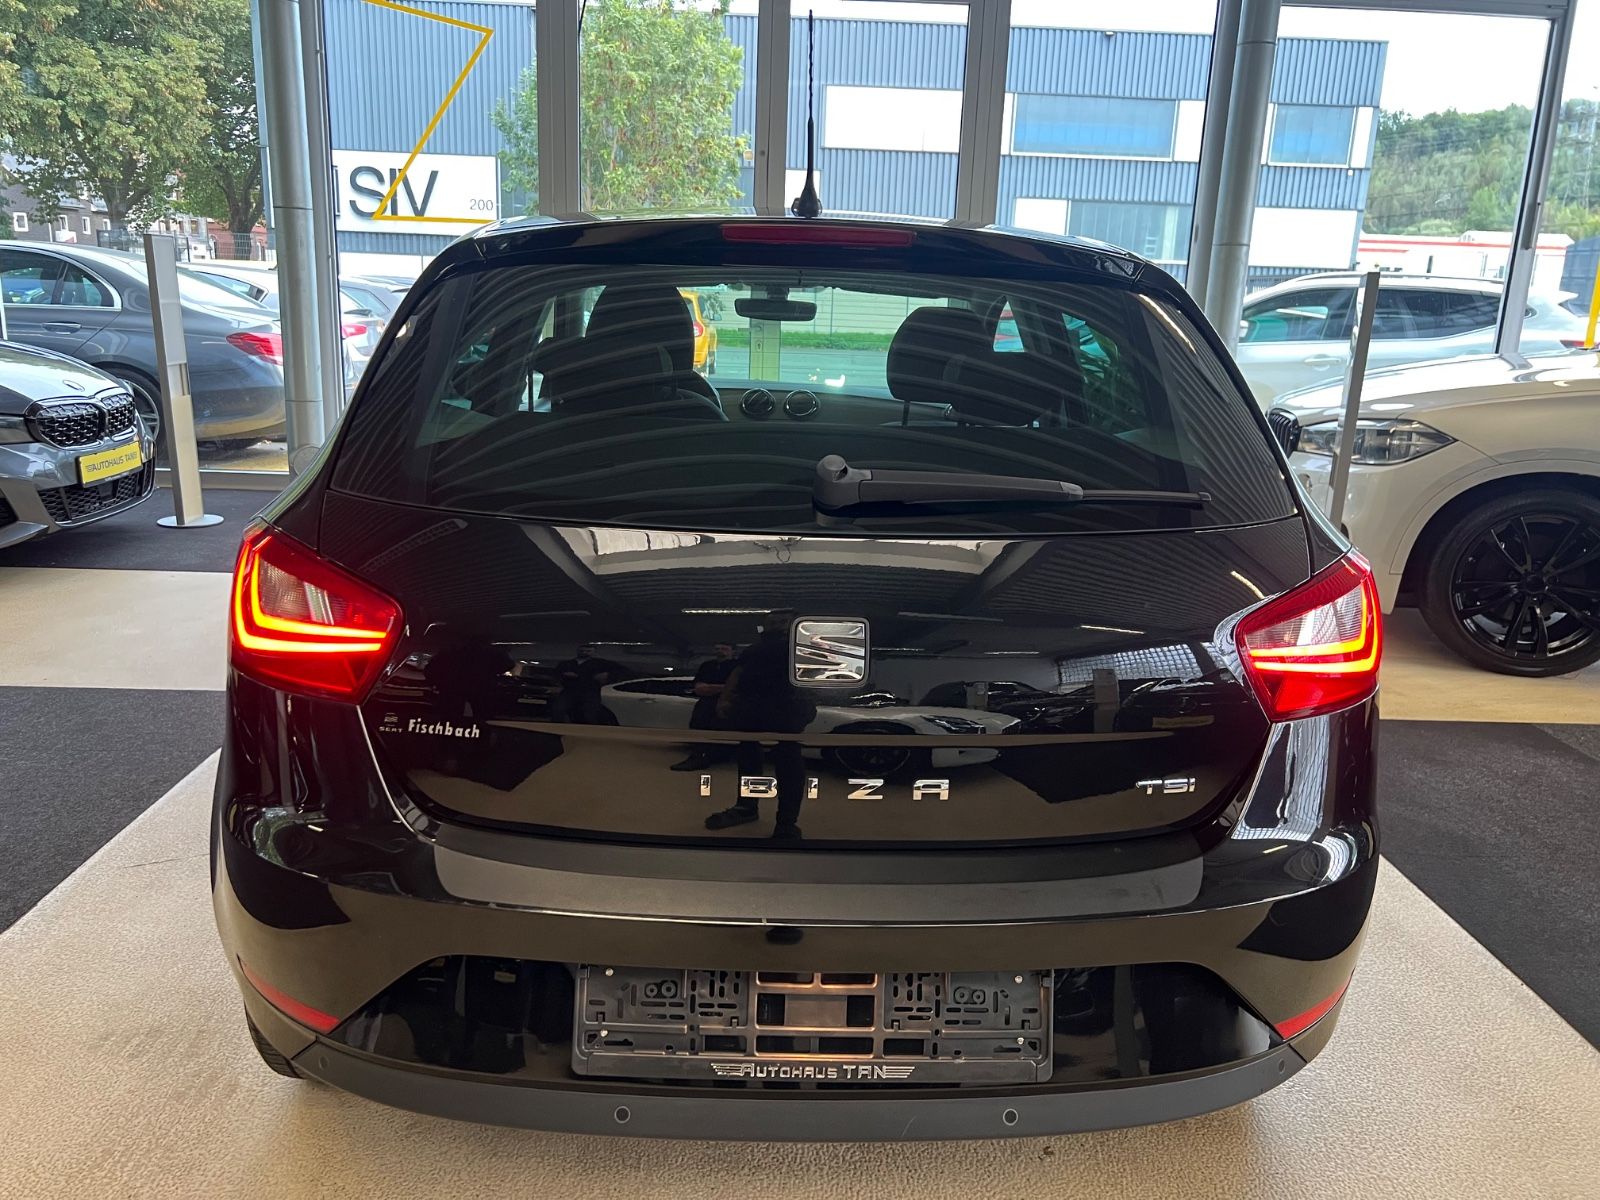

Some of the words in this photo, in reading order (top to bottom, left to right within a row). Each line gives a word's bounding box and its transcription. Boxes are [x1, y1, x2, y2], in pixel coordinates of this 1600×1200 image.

[469, 198, 494, 211] 200
[92, 455, 124, 471] AUTOHAUS
[408, 718, 480, 738] Fischbach
[700, 774, 950, 801] IBIZA
[741, 1062, 838, 1079] AUTOHAUS
[843, 1064, 887, 1079] TAN
